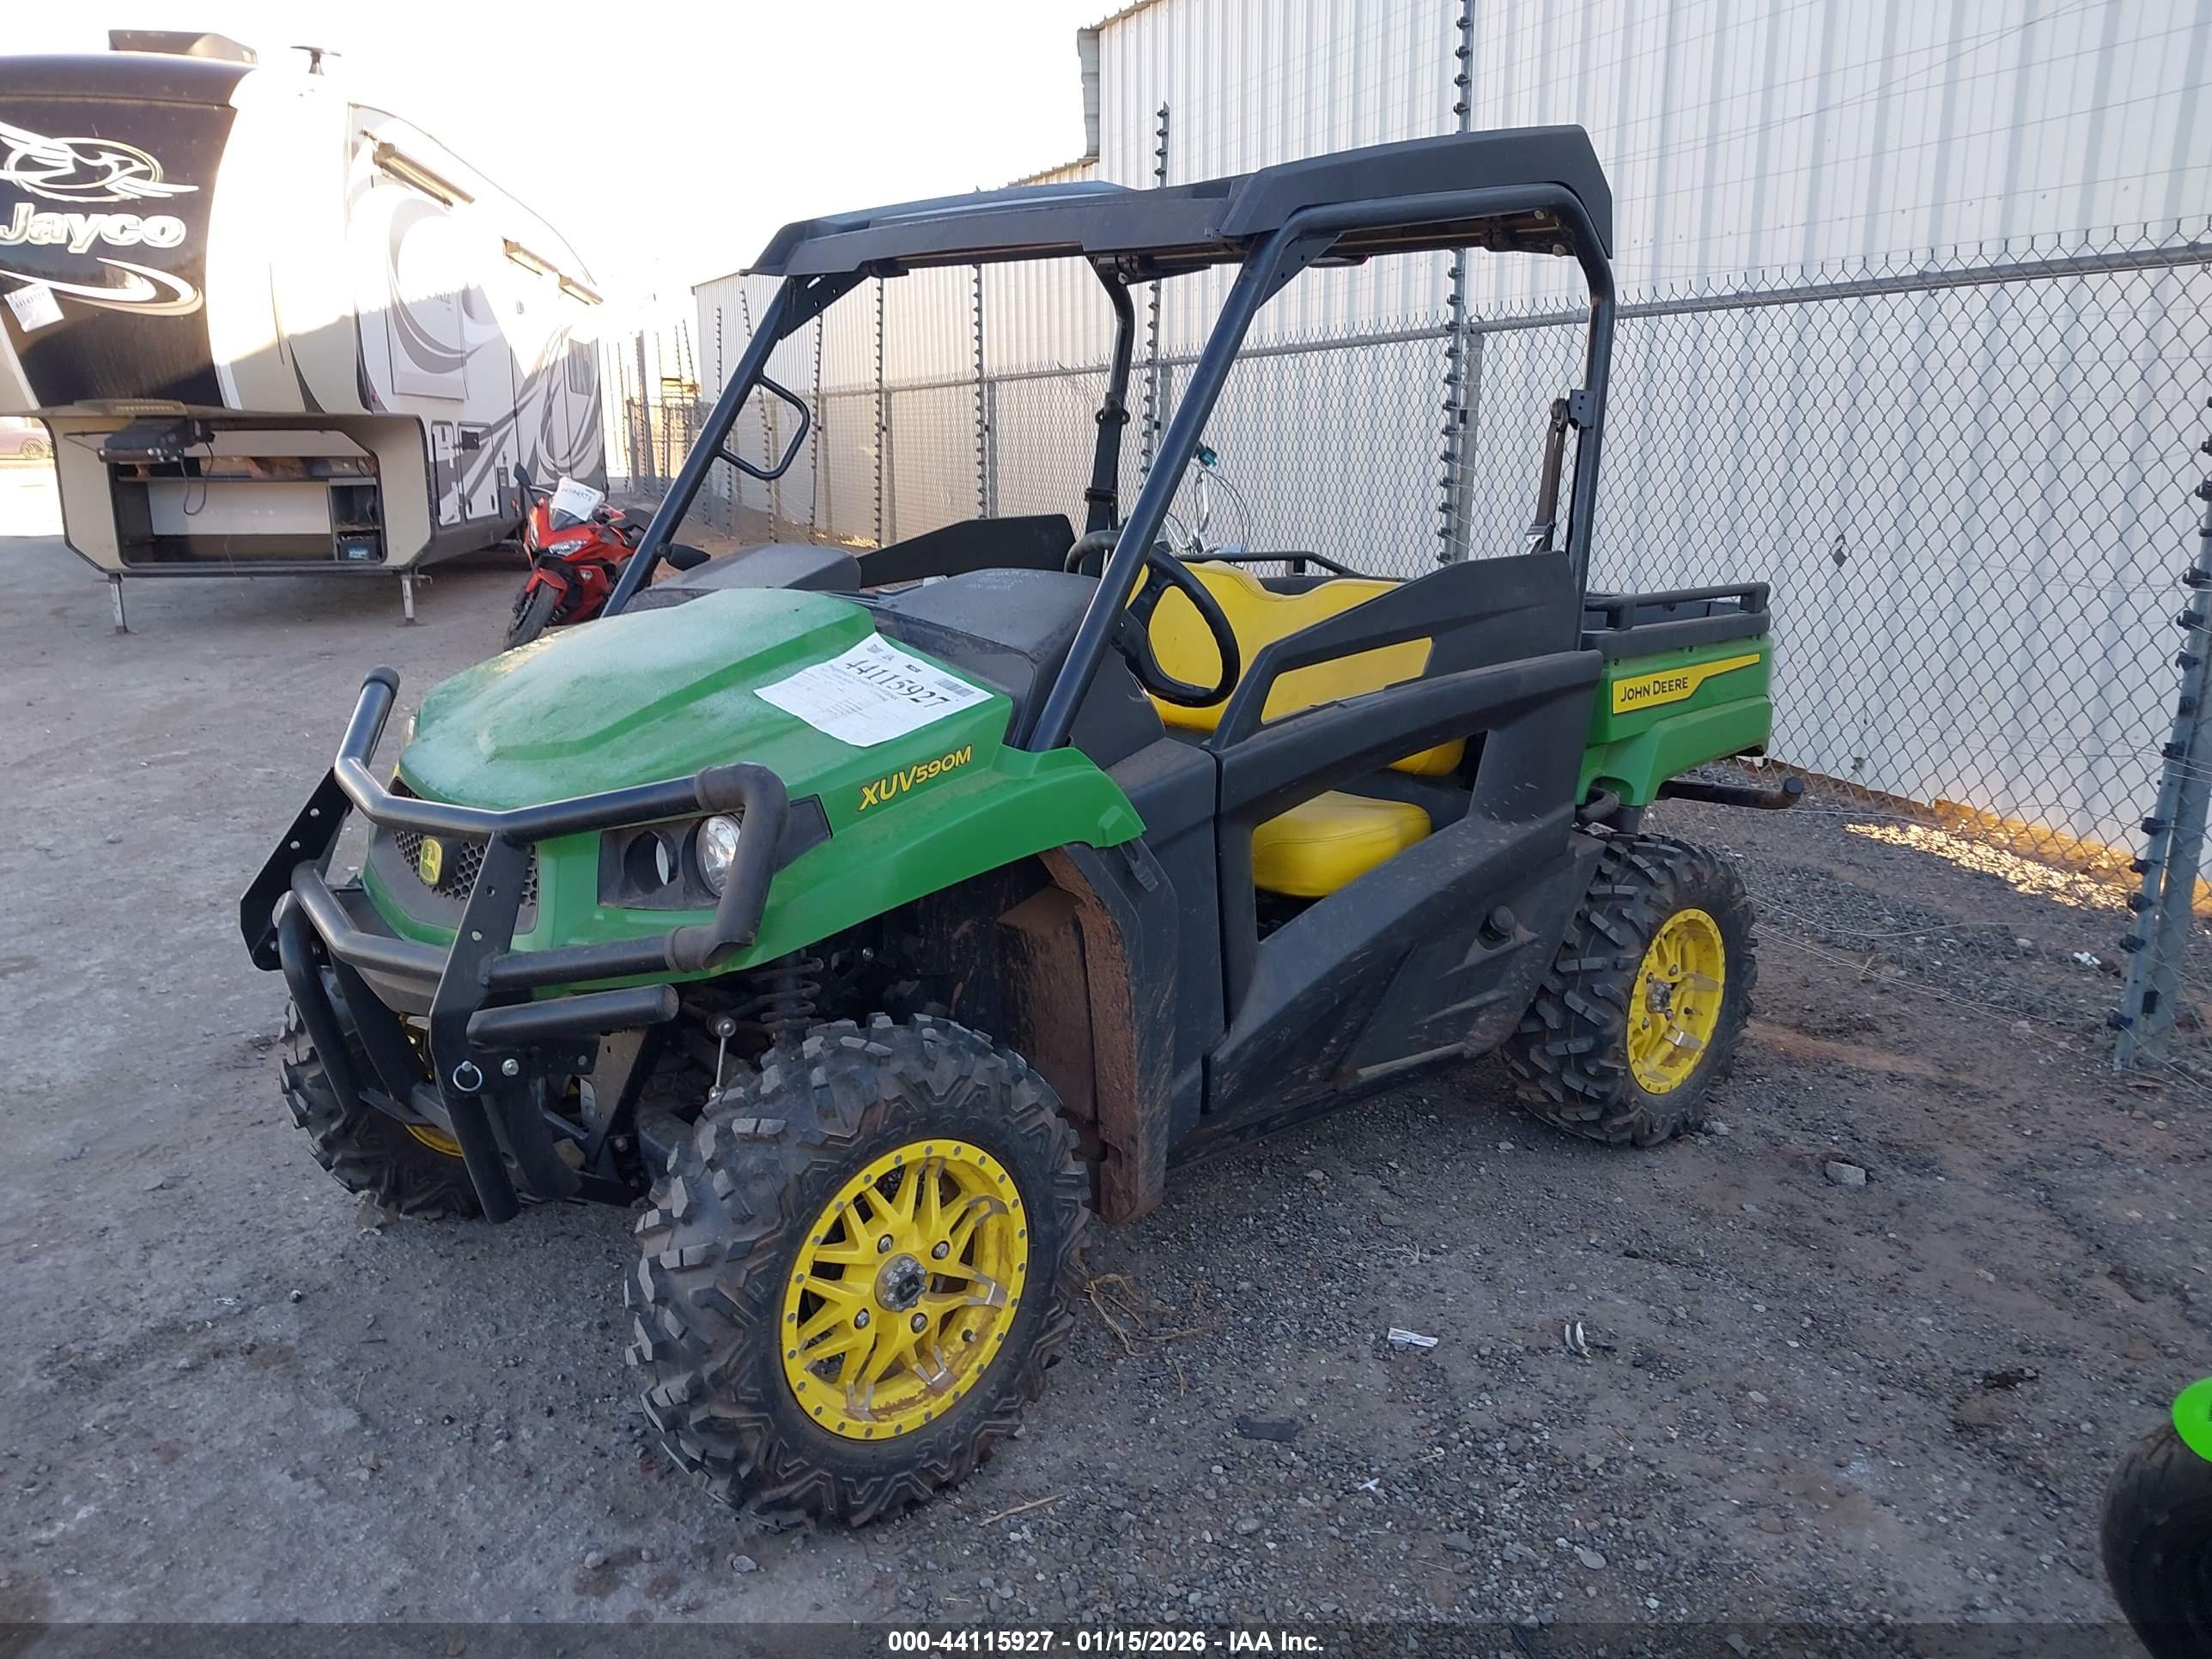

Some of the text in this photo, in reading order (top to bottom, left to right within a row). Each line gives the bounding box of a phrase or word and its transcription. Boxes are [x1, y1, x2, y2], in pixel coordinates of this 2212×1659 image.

[0, 202, 186, 253] Jayco
[845, 659, 951, 708] 44115927
[1620, 677, 1688, 702] JOHN DEERE
[859, 744, 972, 811] XUV590M
